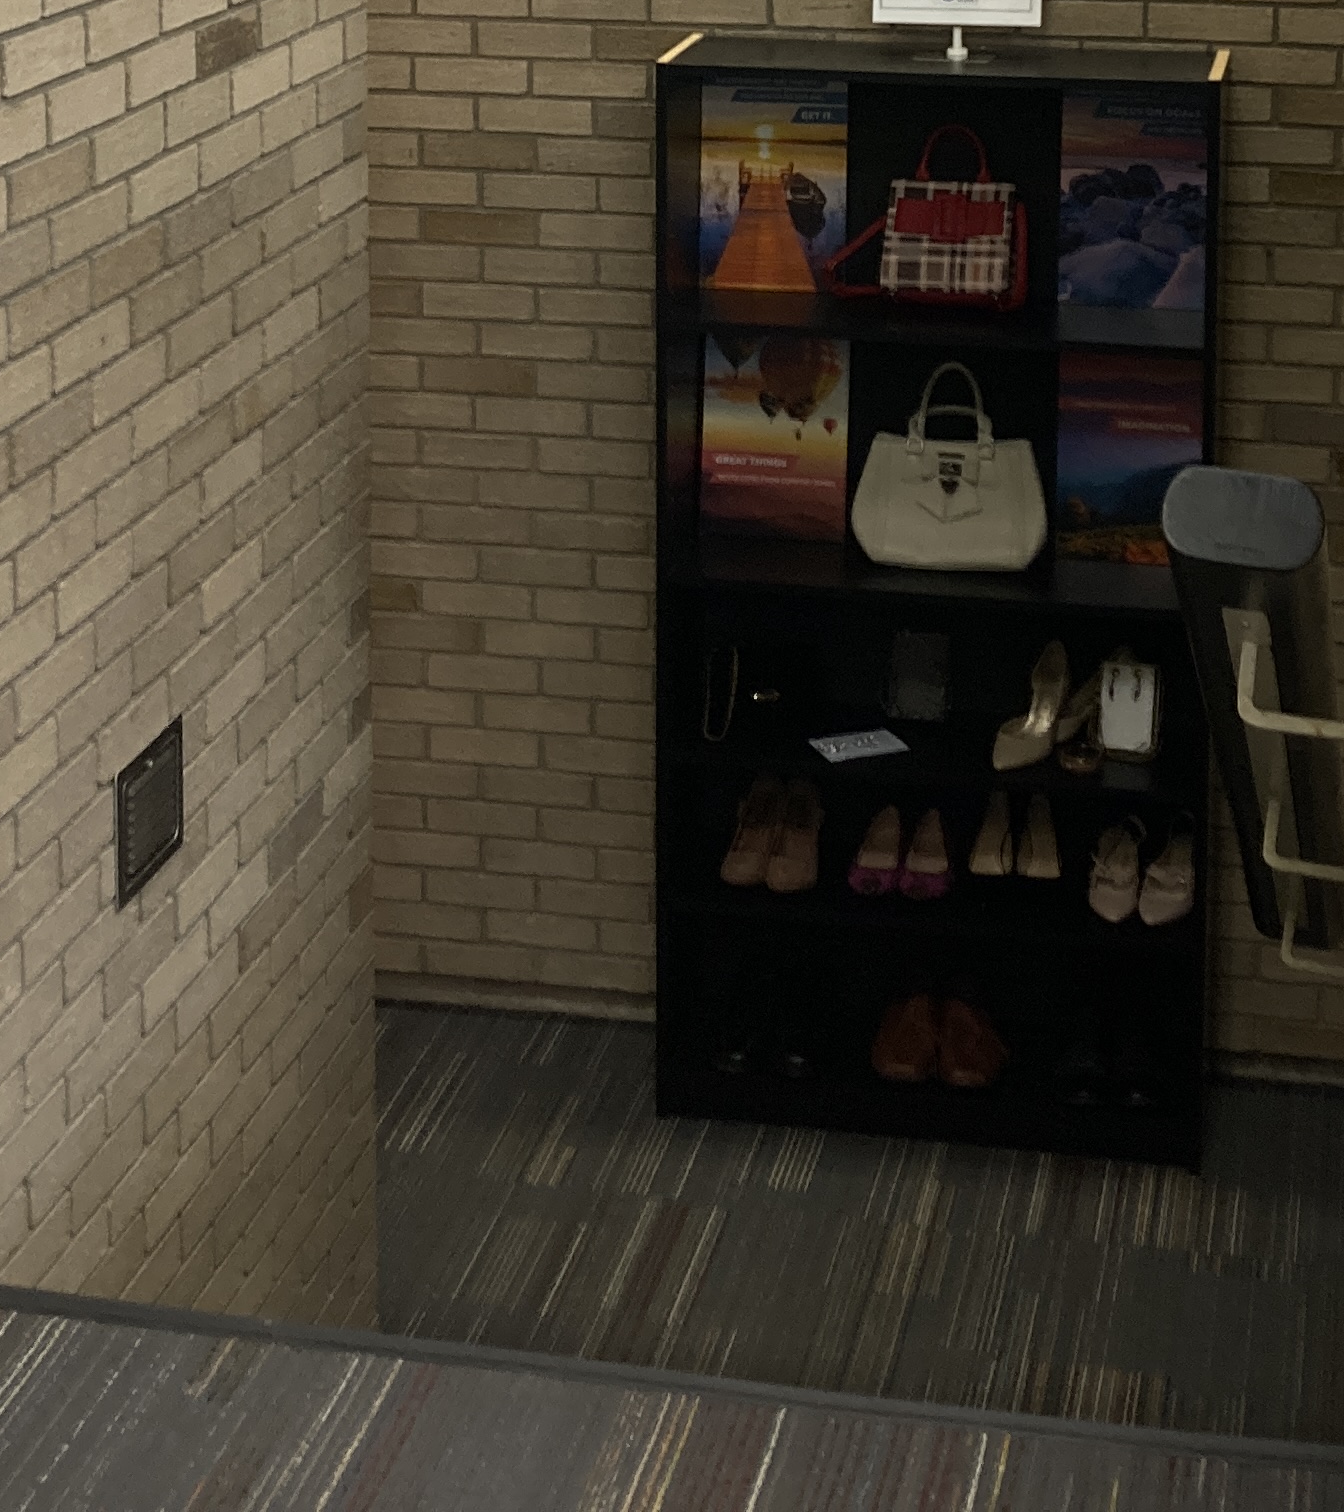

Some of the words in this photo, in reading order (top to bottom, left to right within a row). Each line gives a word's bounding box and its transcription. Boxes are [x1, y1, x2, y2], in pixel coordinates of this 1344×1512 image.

[1117, 420, 1191, 433] IMAGINATION
[715, 455, 747, 466] GREAT
[750, 456, 787, 468] THINGS
